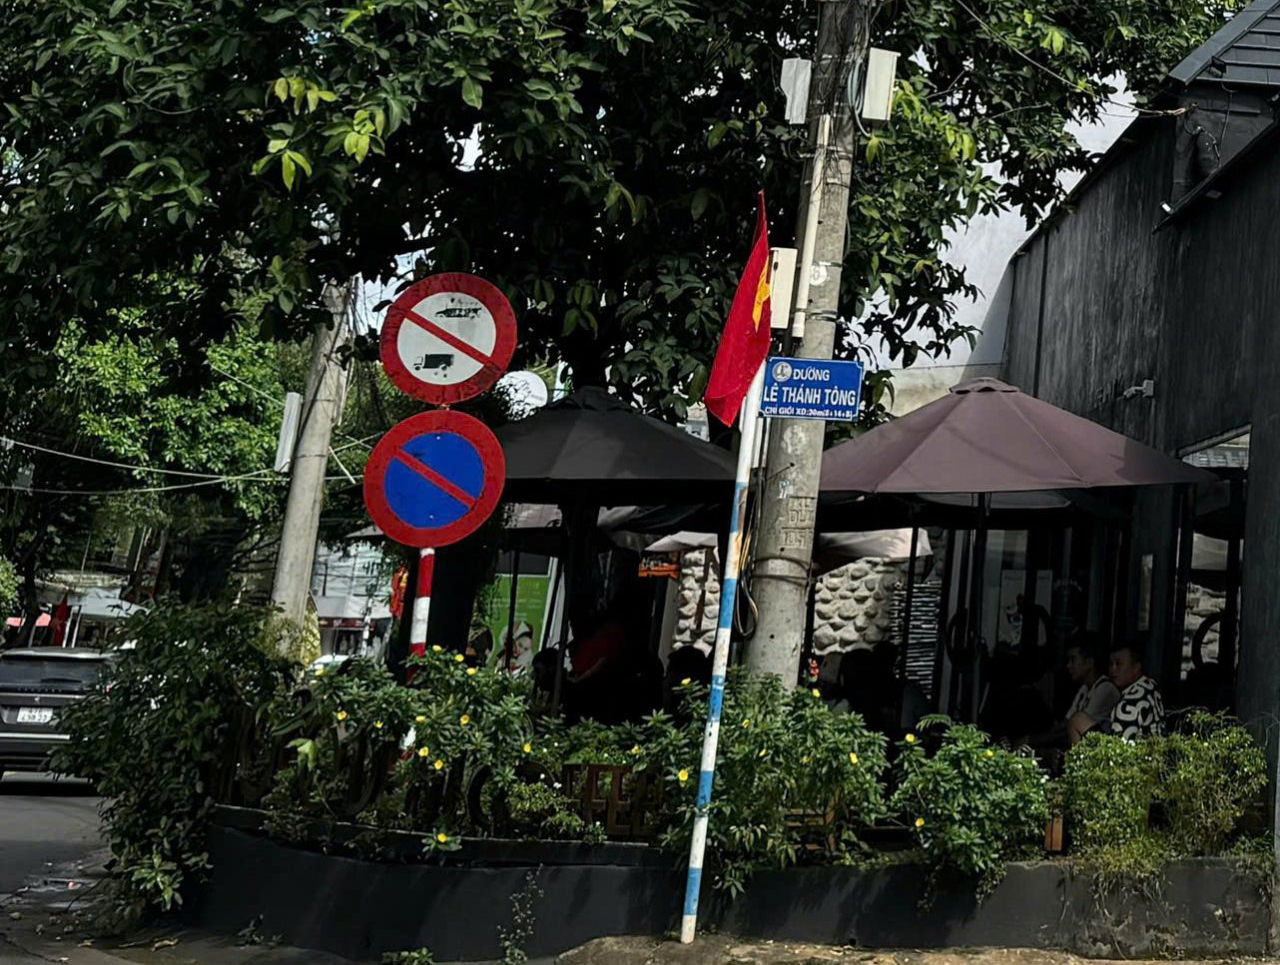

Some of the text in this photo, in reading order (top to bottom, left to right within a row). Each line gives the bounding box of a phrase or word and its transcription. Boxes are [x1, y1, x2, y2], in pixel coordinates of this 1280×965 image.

[763, 382, 856, 406] LÊ THÁNH TÔNG
